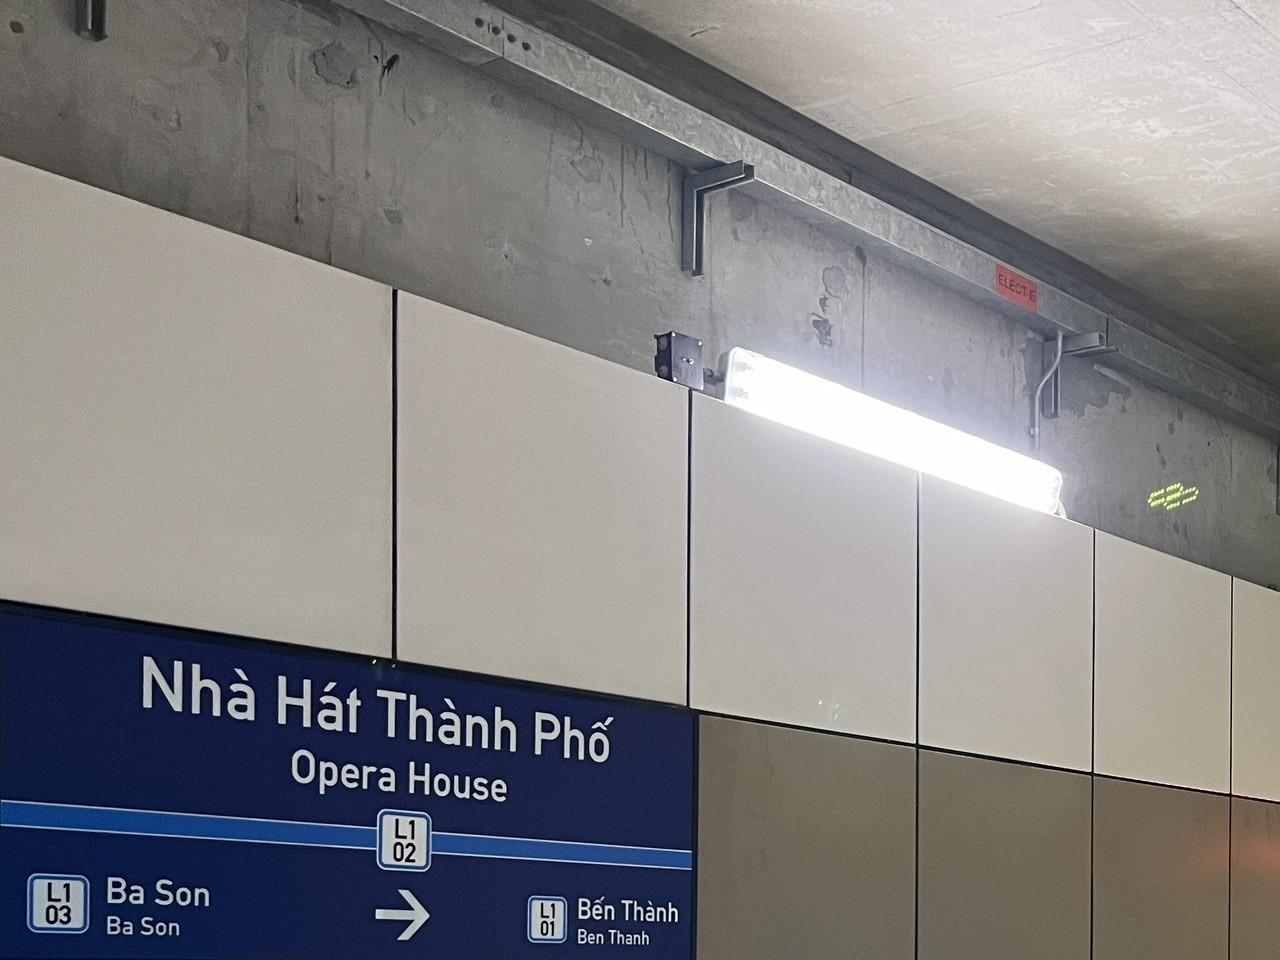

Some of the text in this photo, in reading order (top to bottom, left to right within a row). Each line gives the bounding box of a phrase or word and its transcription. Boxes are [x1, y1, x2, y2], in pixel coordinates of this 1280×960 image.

[142, 655, 615, 763] Nhà Hát Thành Phố
[291, 749, 508, 802] Opera House
[394, 818, 416, 840] L1
[392, 841, 417, 864] 02
[46, 881, 72, 903] L1
[106, 876, 211, 908] Ba Son
[45, 904, 72, 926] 03
[540, 902, 556, 920] L1
[577, 896, 679, 923] Bến Thành
[106, 915, 181, 937] Ba Son
[540, 920, 555, 937] 01
[577, 928, 650, 946] Ben Thanh
